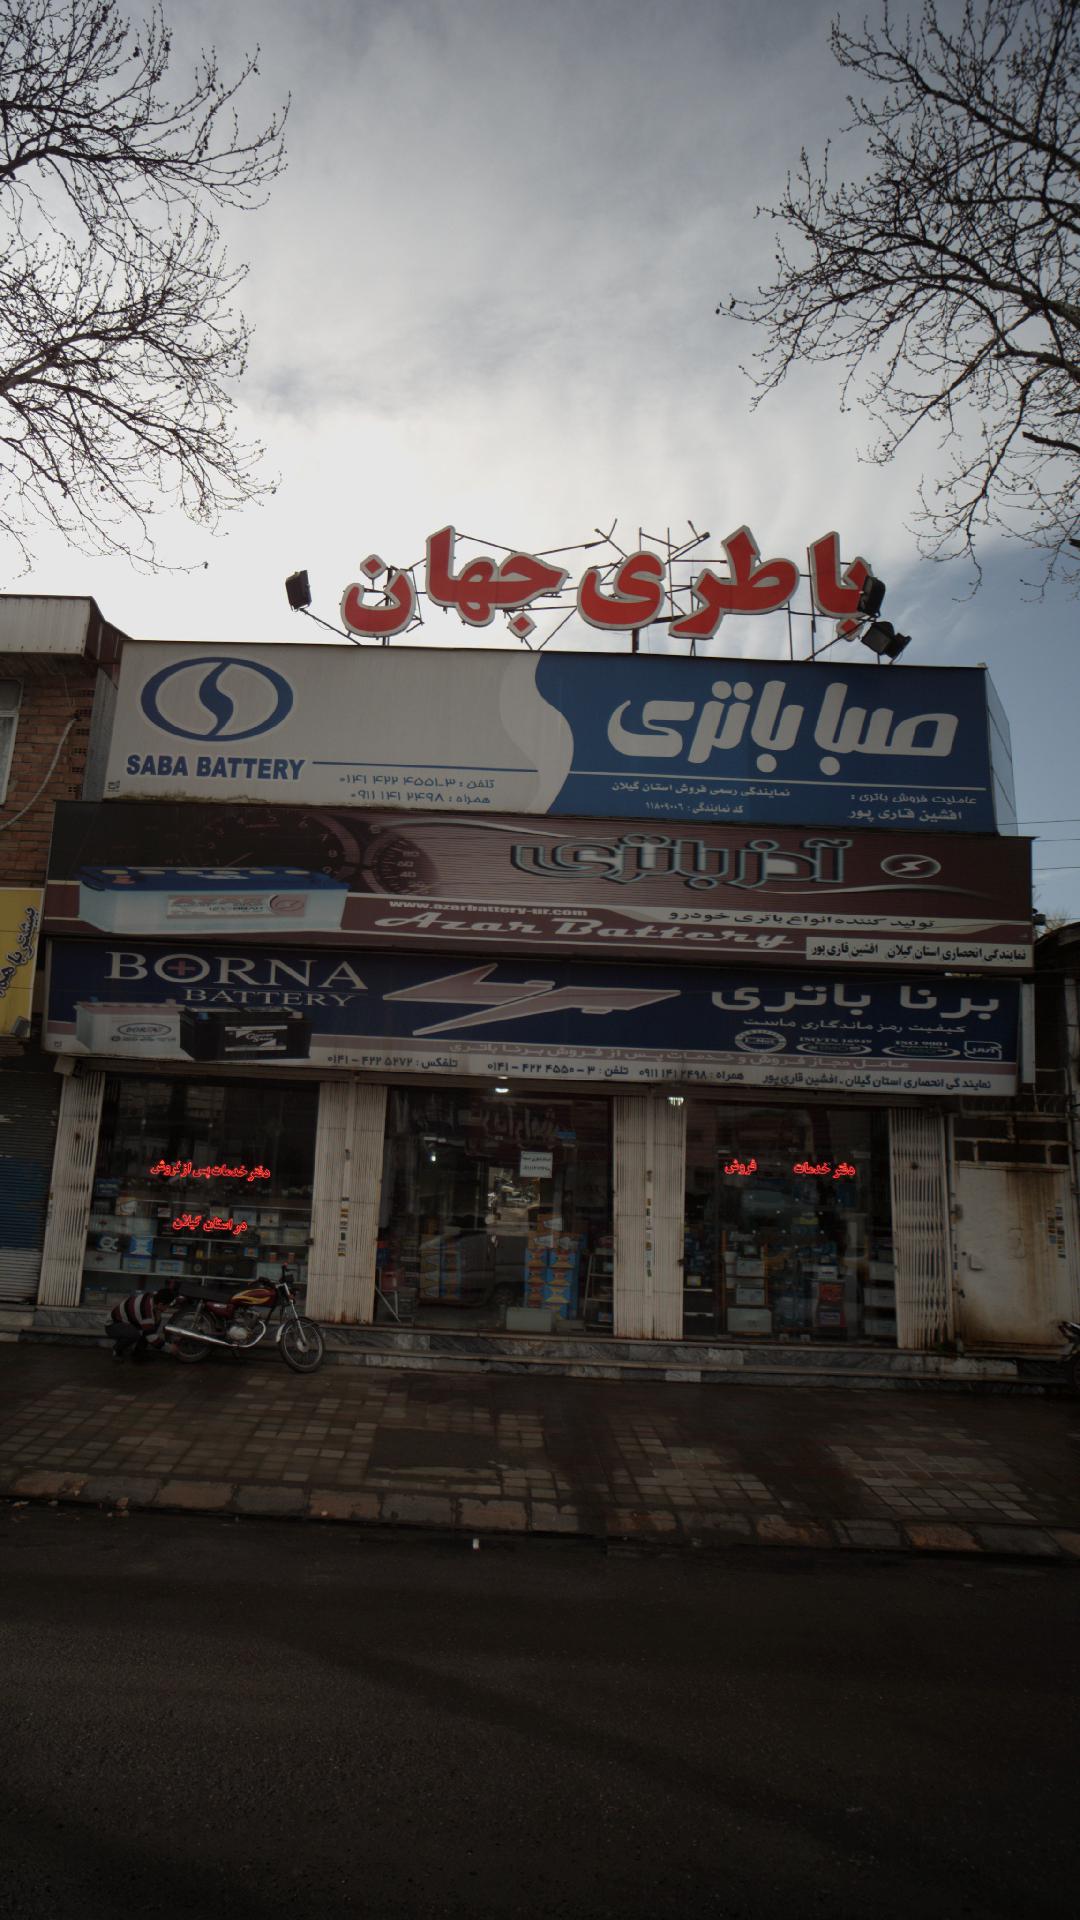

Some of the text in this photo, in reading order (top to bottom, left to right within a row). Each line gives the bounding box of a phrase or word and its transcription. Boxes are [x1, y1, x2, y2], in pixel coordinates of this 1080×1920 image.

[339, 525, 880, 642] باطری جهان
[607, 680, 959, 776] صبا باتری
[126, 755, 305, 780] SABA BATTERY
[612, 780, 791, 798] نمایندگی رسمی فروش استان گیلان
[892, 793, 928, 804] فروش
[732, 804, 744, 814] کد
[848, 807, 962, 823] افشین قاری پور
[670, 911, 936, 930] تولید کننده انواع باتری خودرو
[374, 911, 794, 949] Azar Battery
[827, 941, 849, 957] قاری
[851, 942, 878, 957] افشین
[888, 944, 912, 959] گیلان
[914, 945, 940, 960] استان
[942, 947, 982, 961] انحصاری
[984, 948, 1026, 962] نمایندگی
[104, 951, 368, 990] BORNA
[184, 987, 356, 1007] BATTERY
[711, 983, 999, 1021] برنا باتری
[744, 1017, 967, 1035] کیفیت رمز ماندگاری ماست
[449, 1043, 498, 1055] باتری
[502, 1045, 544, 1056] برنا
[547, 1046, 604, 1058] فروش
[608, 1049, 621, 1060] از
[625, 1052, 663, 1063] پس
[667, 1051, 734, 1062] خدمات
[750, 1054, 806, 1066] فروش
[810, 1056, 850, 1068] مجاز
[853, 1058, 909, 1069] عامل
[762, 1073, 780, 1086] پور
[780, 1072, 803, 1085] قاری
[805, 1073, 838, 1085] افشین
[845, 1073, 871, 1086] گیلان
[873, 1075, 901, 1088] استان
[904, 1077, 944, 1089] انحصاری
[946, 1078, 991, 1090] نمایندگی
[150, 1159, 271, 1182] دفتر خدمات پس از فروش
[723, 1157, 856, 1179] دفتر خدمات فروش
[172, 1212, 249, 1236] در استان گیلان
